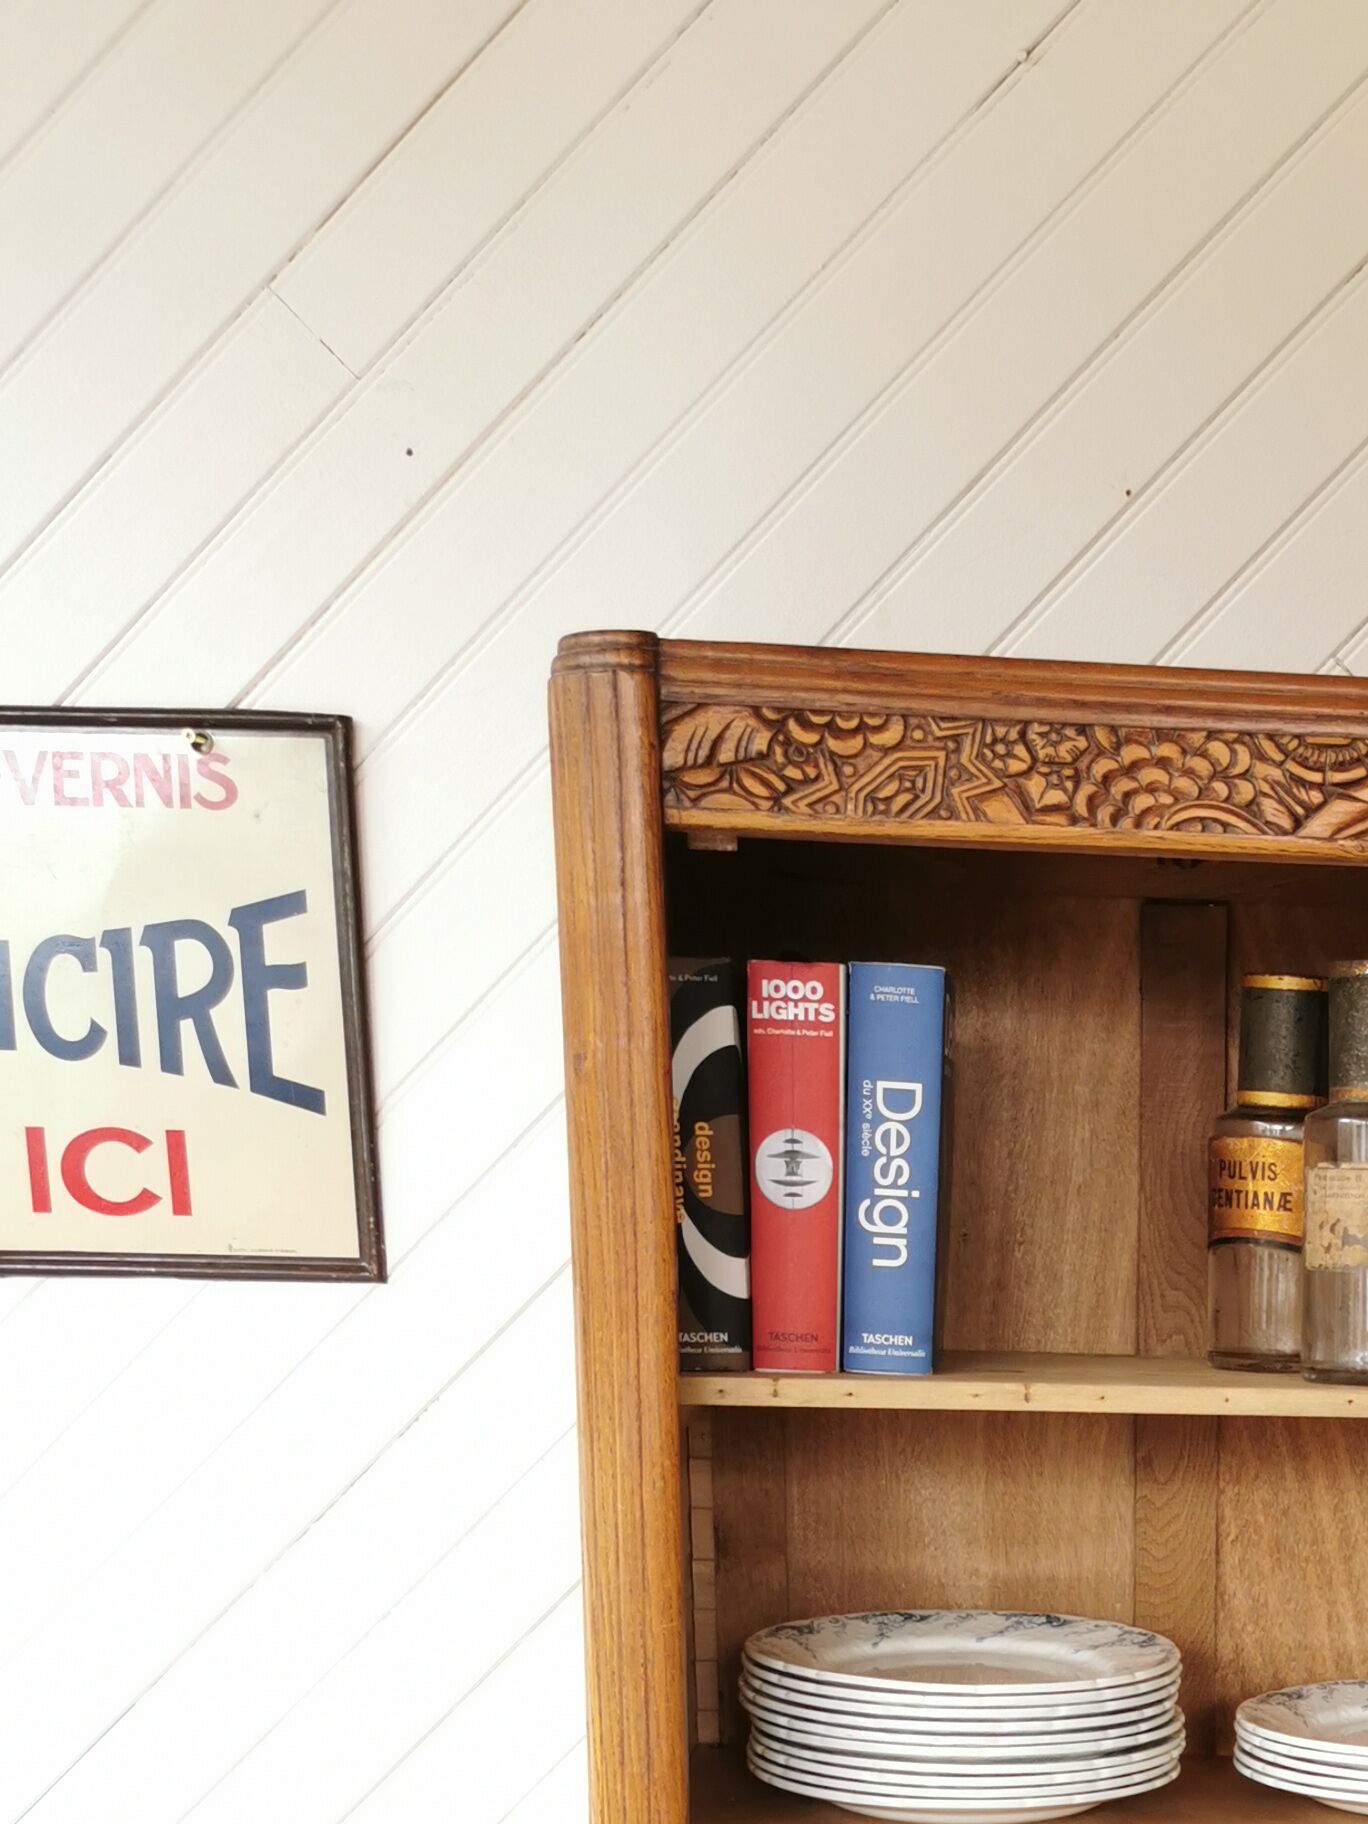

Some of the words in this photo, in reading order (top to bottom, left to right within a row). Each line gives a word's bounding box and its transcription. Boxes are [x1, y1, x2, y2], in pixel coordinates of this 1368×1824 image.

[3, 749, 239, 812] VERNIS
[761, 979, 824, 1001] 1000
[751, 1000, 836, 1023] LIGHTS
[862, 1079, 874, 1096] du
[693, 1121, 717, 1198] design
[1218, 1159, 1279, 1181] PULVIS
[25, 1126, 193, 1217] ICI
[858, 1080, 923, 1268] Design
[861, 1332, 913, 1347] TASCHEN
